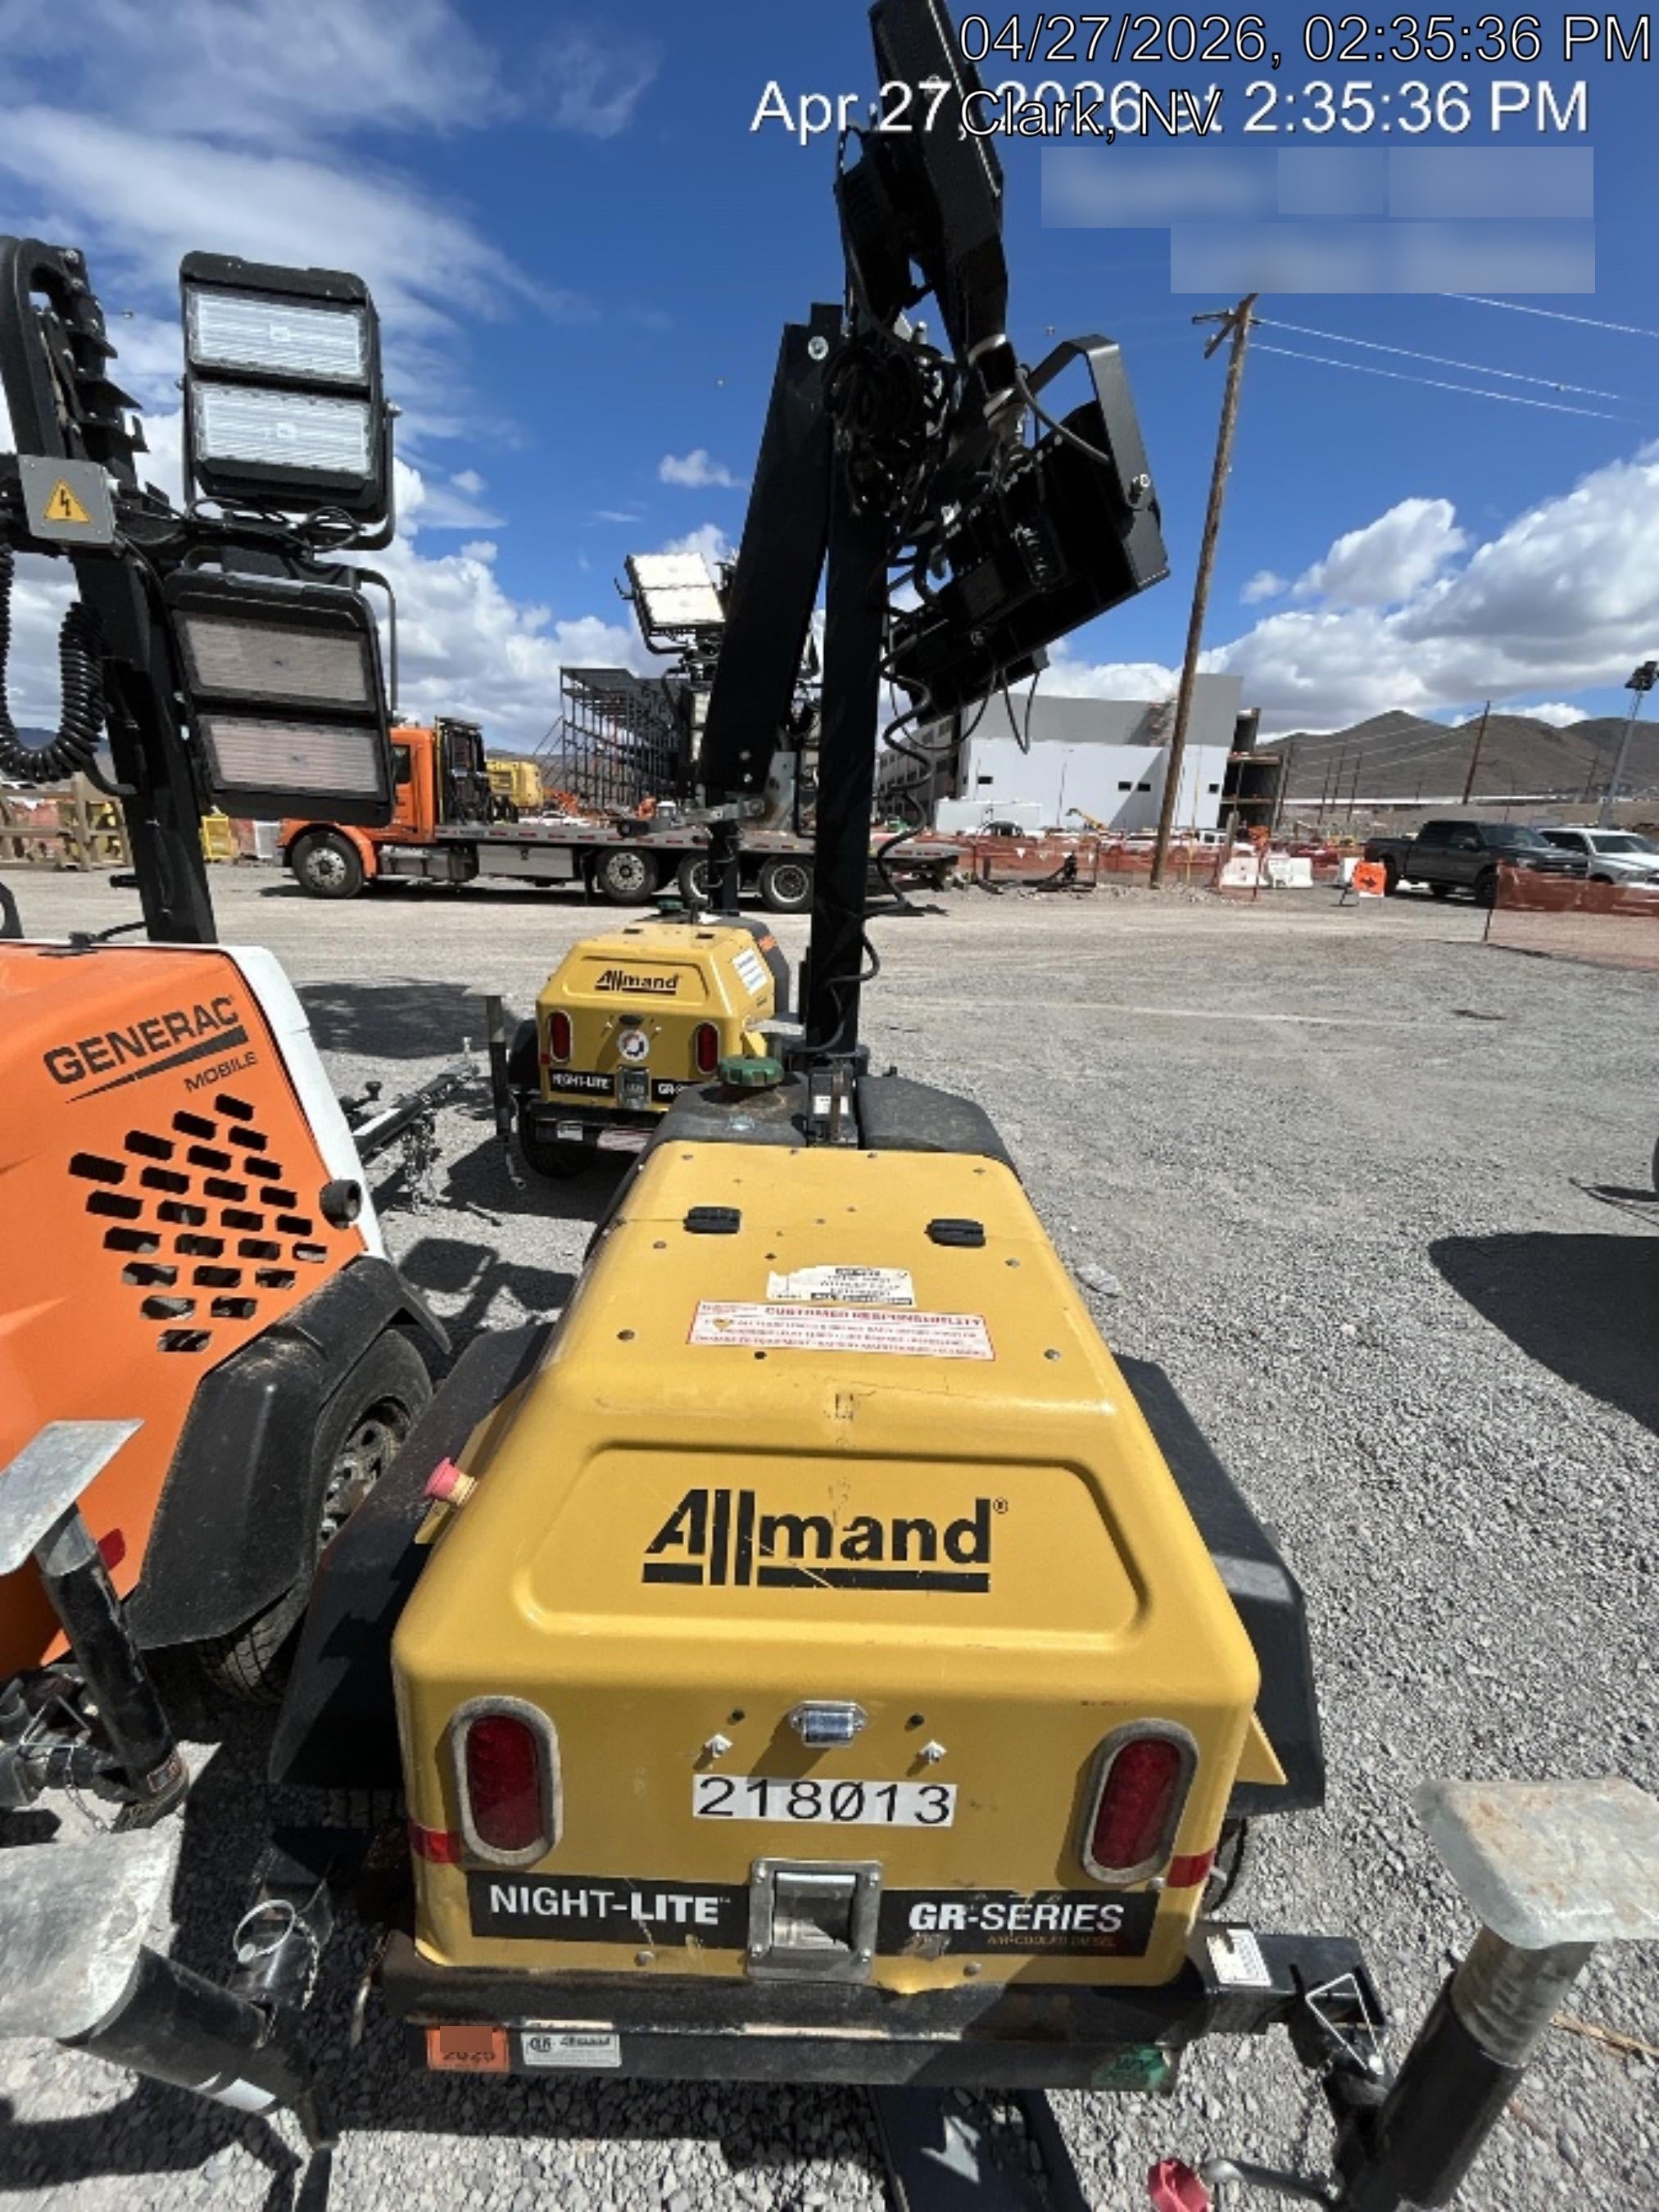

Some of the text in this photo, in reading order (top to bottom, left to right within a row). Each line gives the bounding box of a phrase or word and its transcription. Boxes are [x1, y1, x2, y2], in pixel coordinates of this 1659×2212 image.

[595, 969, 680, 995] Allmand
[43, 996, 239, 1085] GENERAC
[184, 1051, 257, 1093] MOBILE
[696, 1775, 950, 1824] 218013
[908, 1902, 1126, 1933] GR-SERIES
